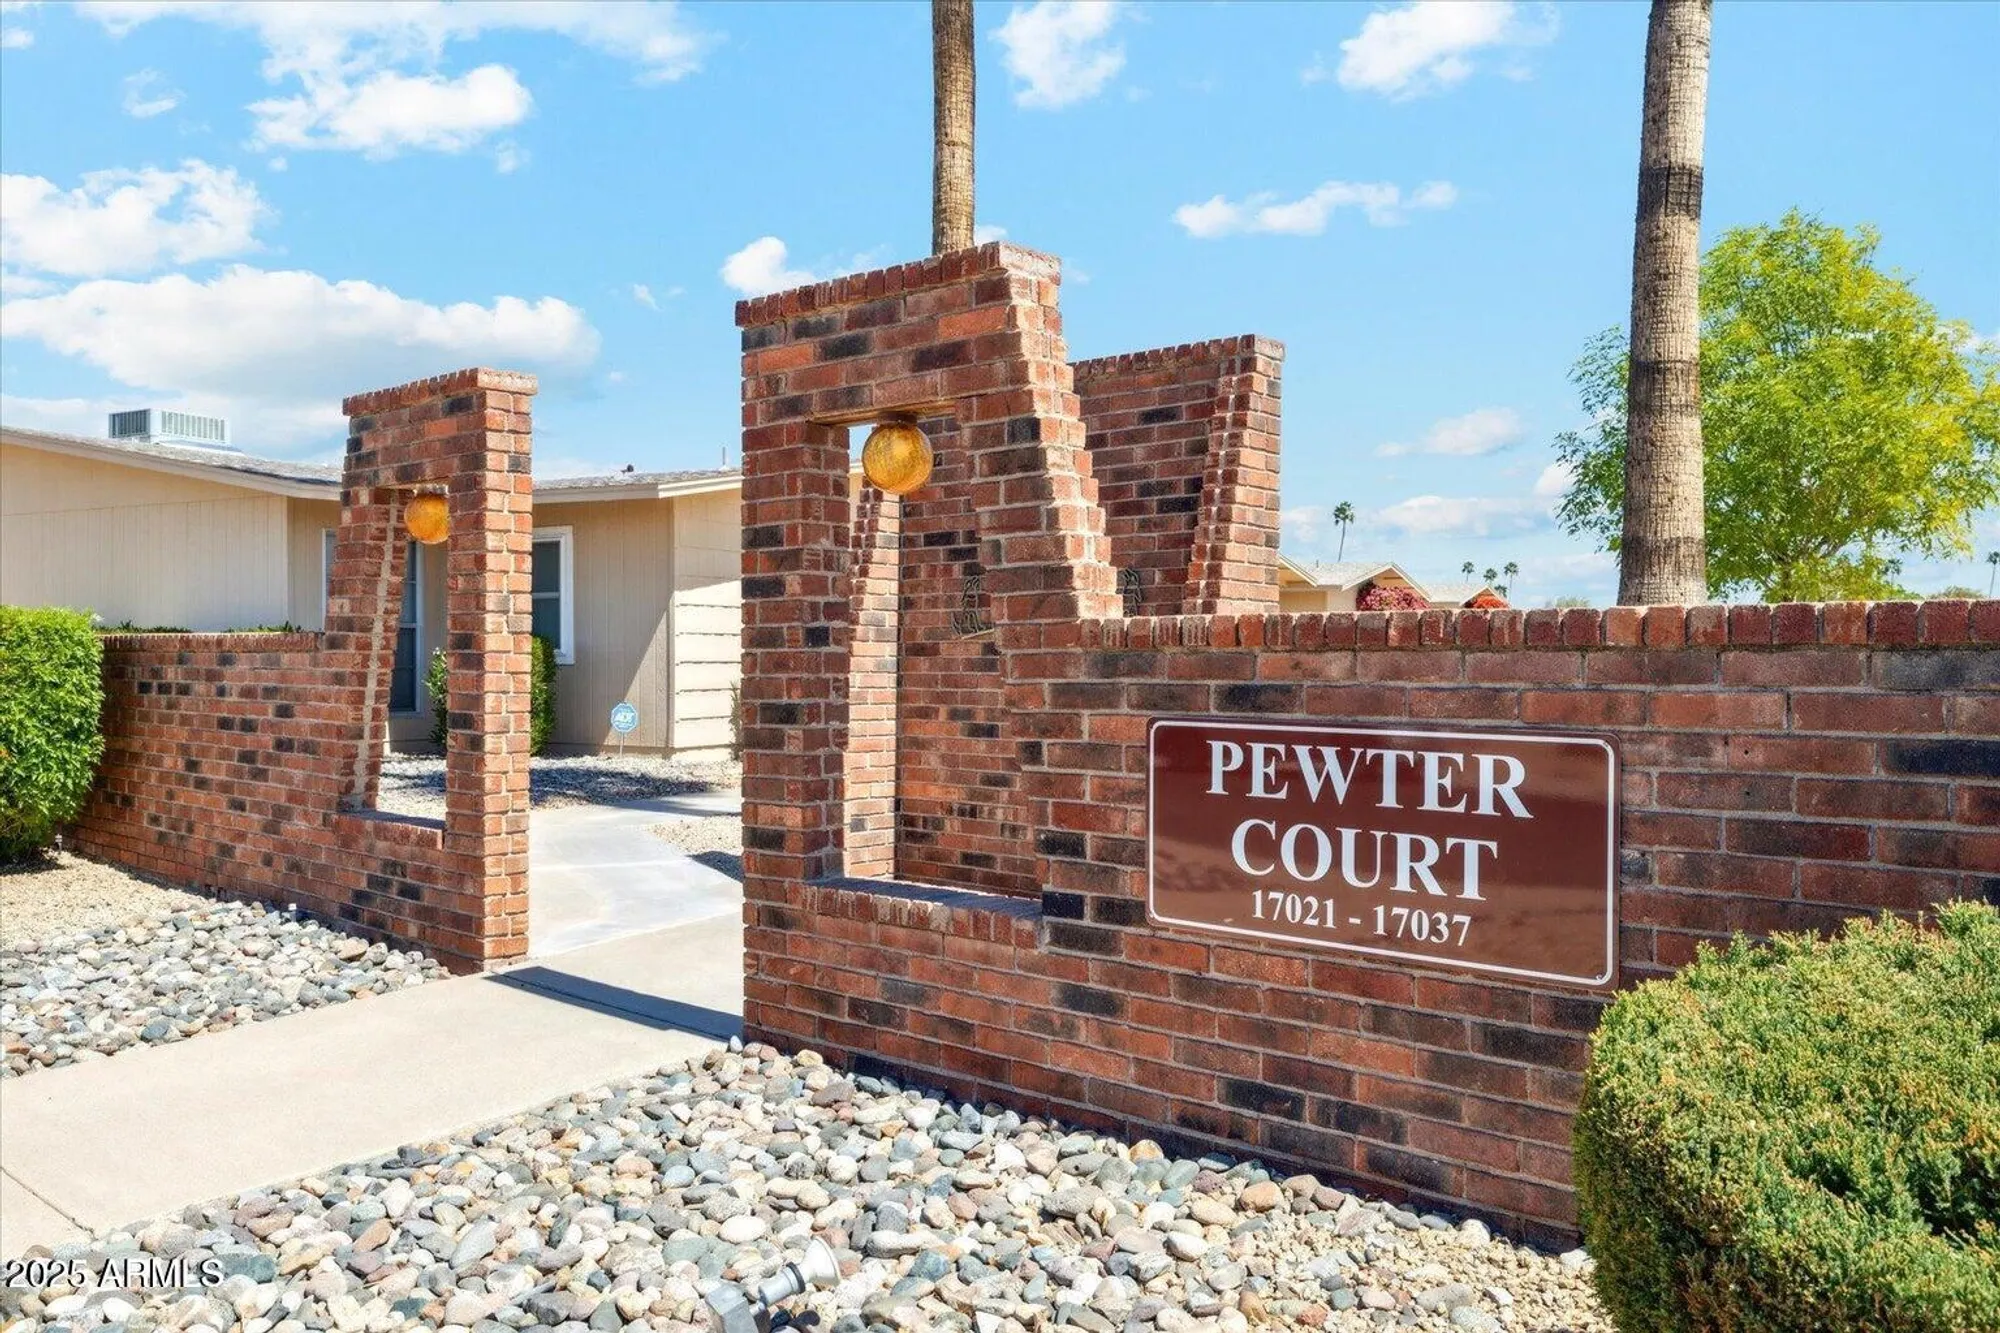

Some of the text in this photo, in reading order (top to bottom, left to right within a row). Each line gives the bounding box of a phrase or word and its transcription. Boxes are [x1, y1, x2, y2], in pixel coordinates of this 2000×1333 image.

[1206, 740, 1533, 818] PEWTER
[1231, 819, 1497, 900] COURT
[1252, 890, 1336, 929] 17021
[1373, 904, 1471, 946] 17037
